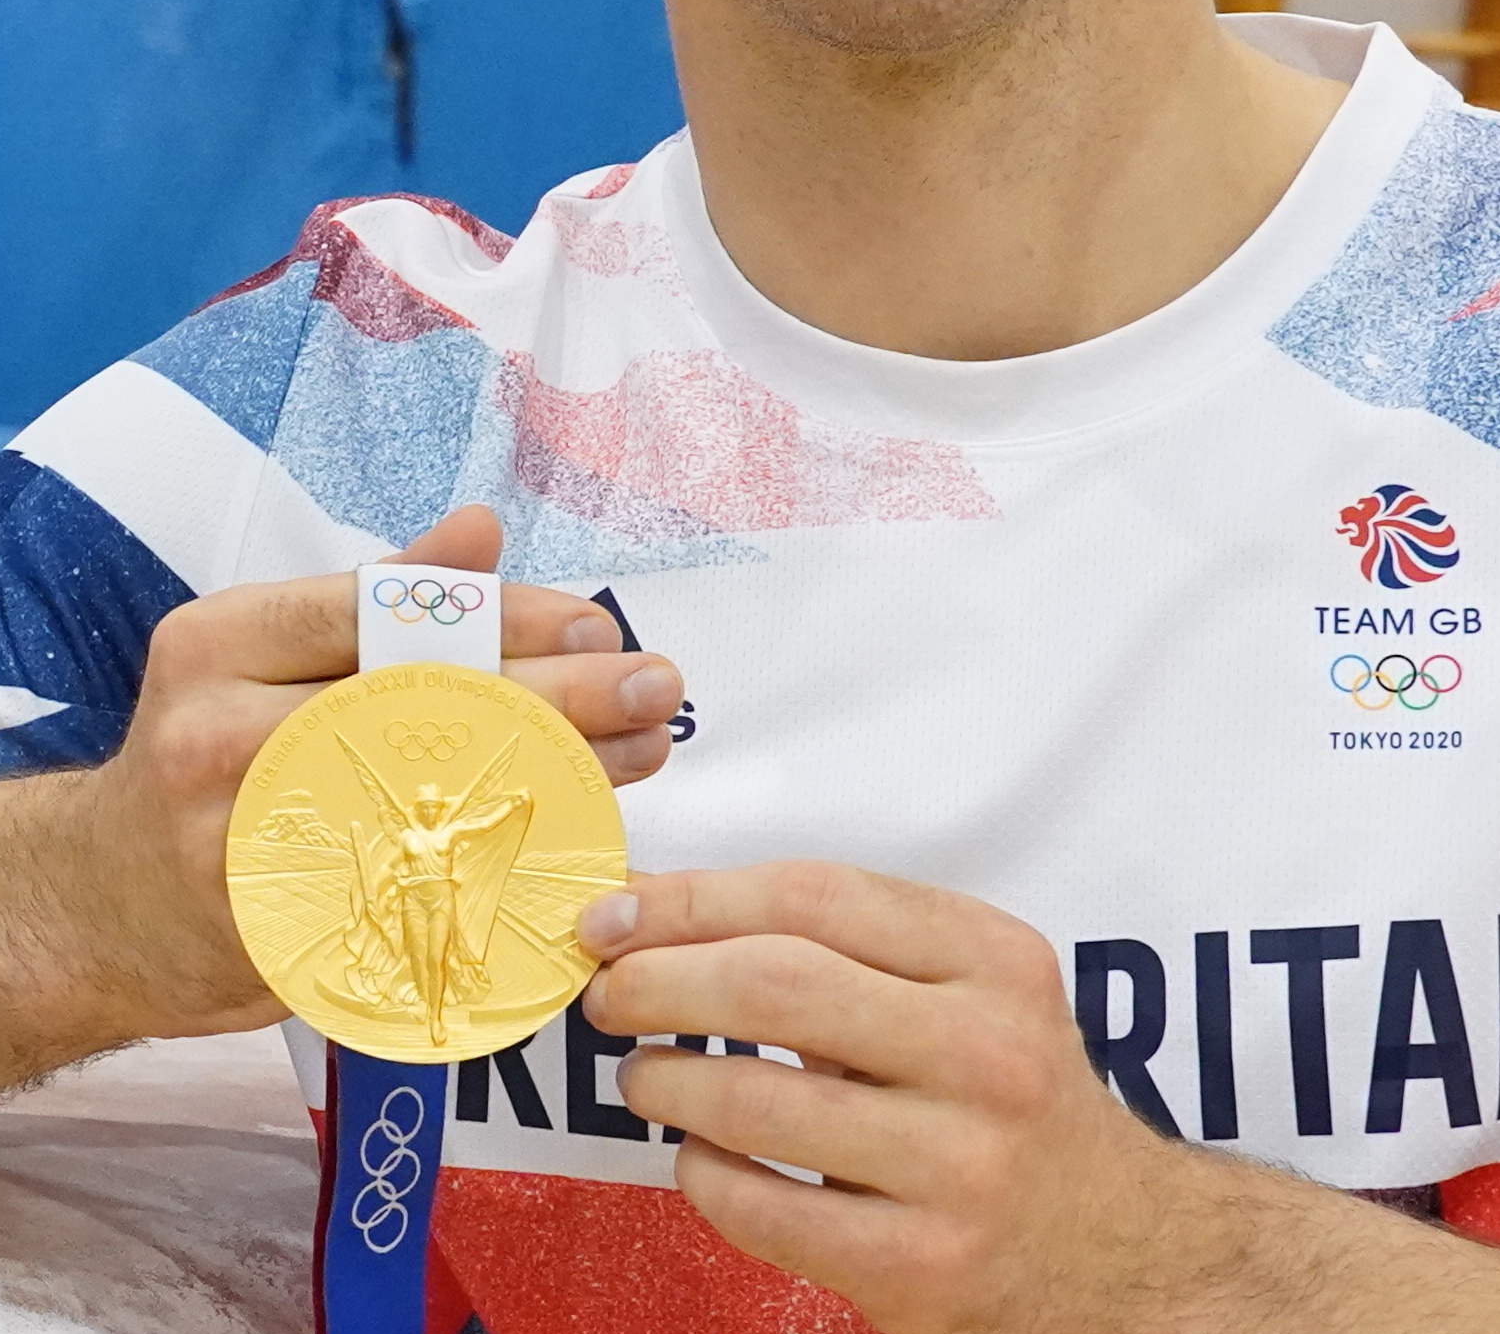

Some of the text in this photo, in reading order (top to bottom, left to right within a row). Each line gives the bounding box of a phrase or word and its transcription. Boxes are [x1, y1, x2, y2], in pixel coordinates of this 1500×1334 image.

[1314, 606, 1482, 636] TEAM GB
[253, 667, 604, 795] Games of the XXXII Olympiad Tokyo 2020
[1329, 730, 1463, 750] TOKYO 2020
